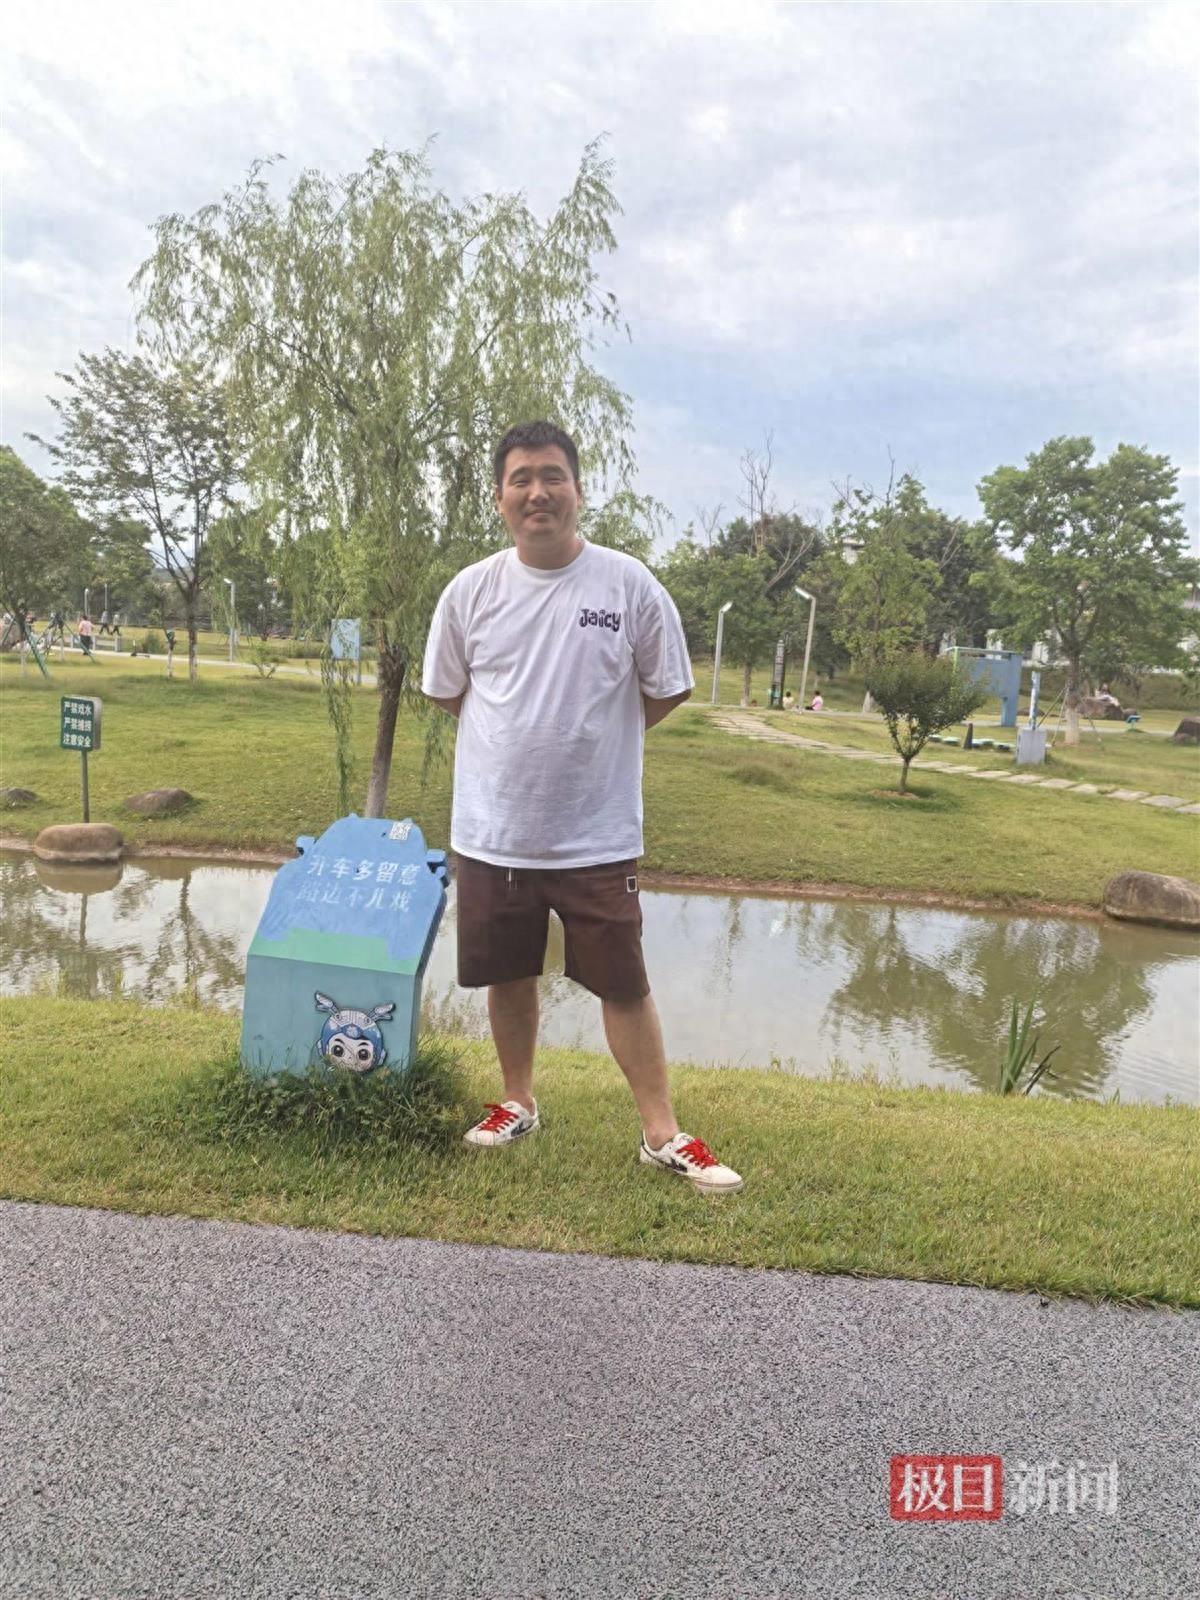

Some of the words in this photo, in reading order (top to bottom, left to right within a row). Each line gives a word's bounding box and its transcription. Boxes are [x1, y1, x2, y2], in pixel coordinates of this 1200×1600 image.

[579, 608, 621, 632] Jaicy
[63, 732, 92, 748] 注意安全
